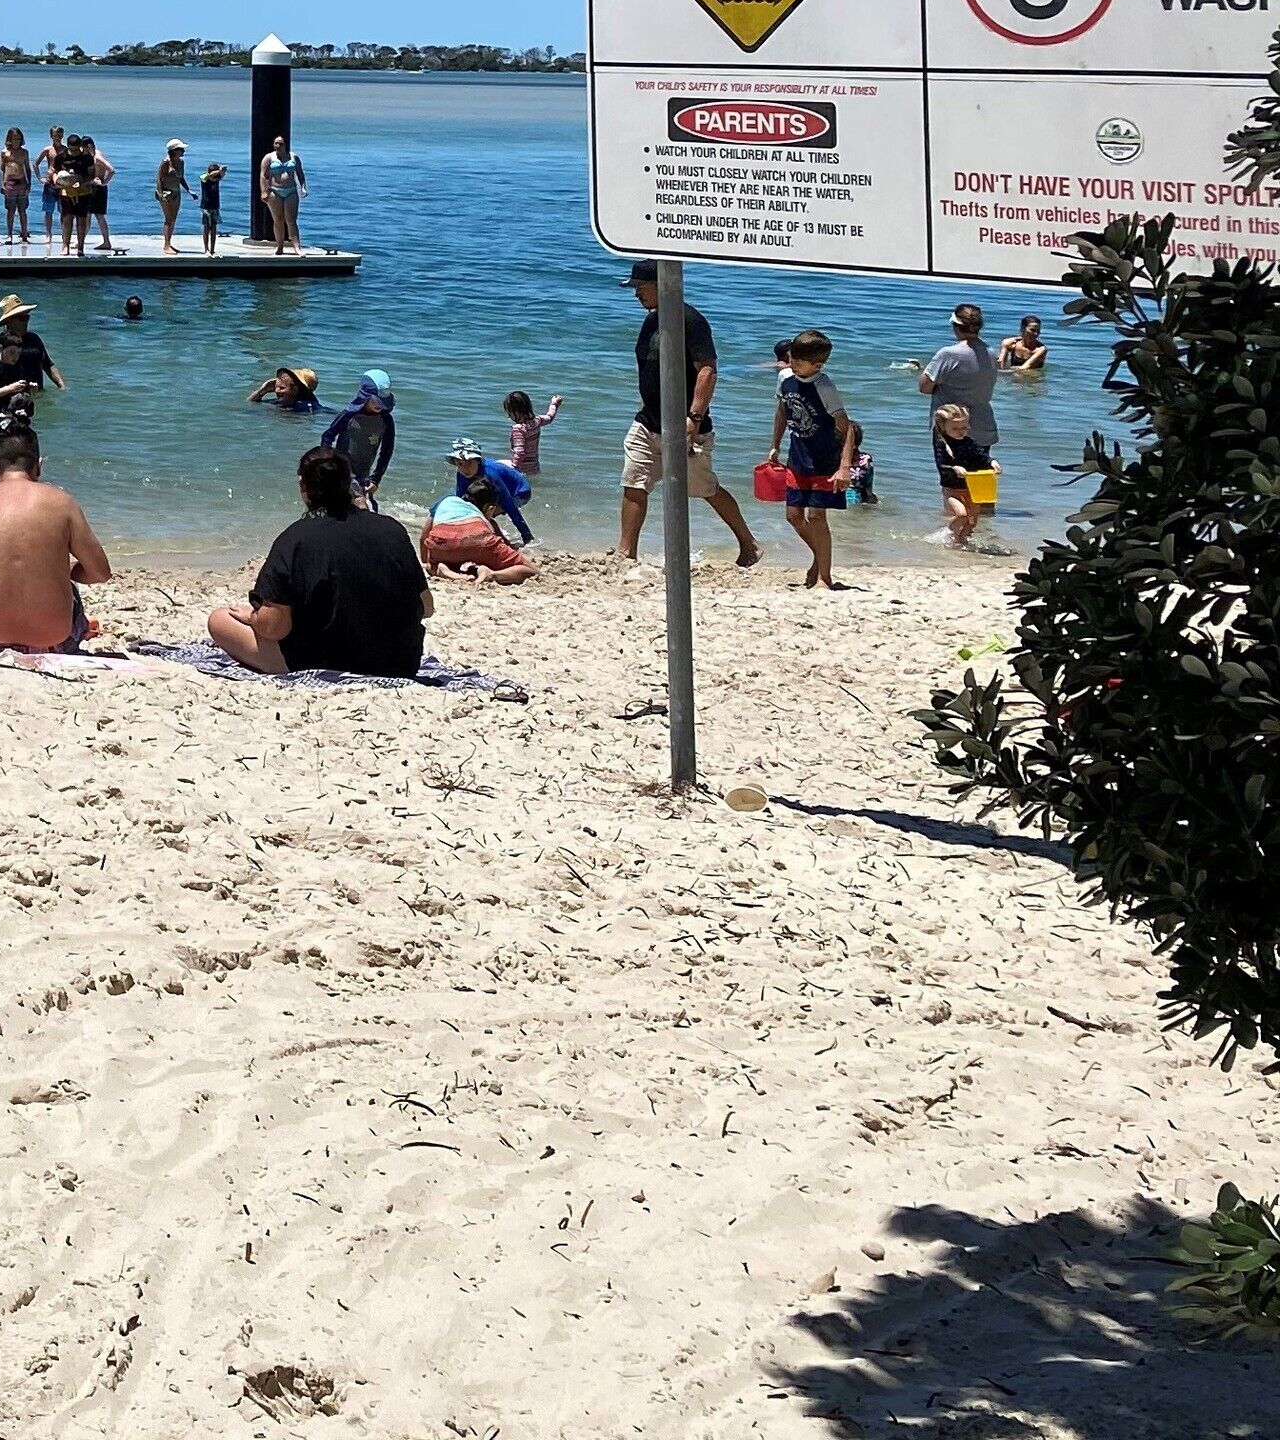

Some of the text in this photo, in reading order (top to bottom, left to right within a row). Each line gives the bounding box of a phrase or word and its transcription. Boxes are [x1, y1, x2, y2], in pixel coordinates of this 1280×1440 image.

[635, 81, 655, 90] YOUR
[658, 81, 686, 91] CHILD'S
[688, 82, 718, 91] SAFETY
[720, 83, 728, 92] IS
[731, 83, 752, 92] YOUR
[819, 85, 829, 94] AT
[831, 85, 847, 95] ALL
[850, 86, 878, 96] TIMES!
[694, 110, 807, 136] PARENTS
[655, 145, 840, 164] WATCH YOUR CHILDREN AT ALL TIMES
[656, 165, 872, 186] YOU MUST CLOSELY WATCH YOUR CHILDREN
[656, 179, 854, 202] WHENEVER THEY ARE NEAR THE WATER,
[954, 171, 1012, 194] DON'T
[1019, 175, 1071, 196] HAVE
[1077, 178, 1135, 200] YOUR
[1142, 180, 1197, 203] VISIT
[656, 193, 810, 213] REGARDLESS OF THEIR ABILITY.
[656, 212, 864, 237] CHILDREN UNDER THE AGE OF 13 MUST BE
[940, 200, 1280, 235] Thefts from vehicles hae ocured in this
[657, 227, 794, 247] ACCOMPANIED BY AN ADULT.
[979, 227, 1070, 249] Please take
[1202, 242, 1239, 259] with
